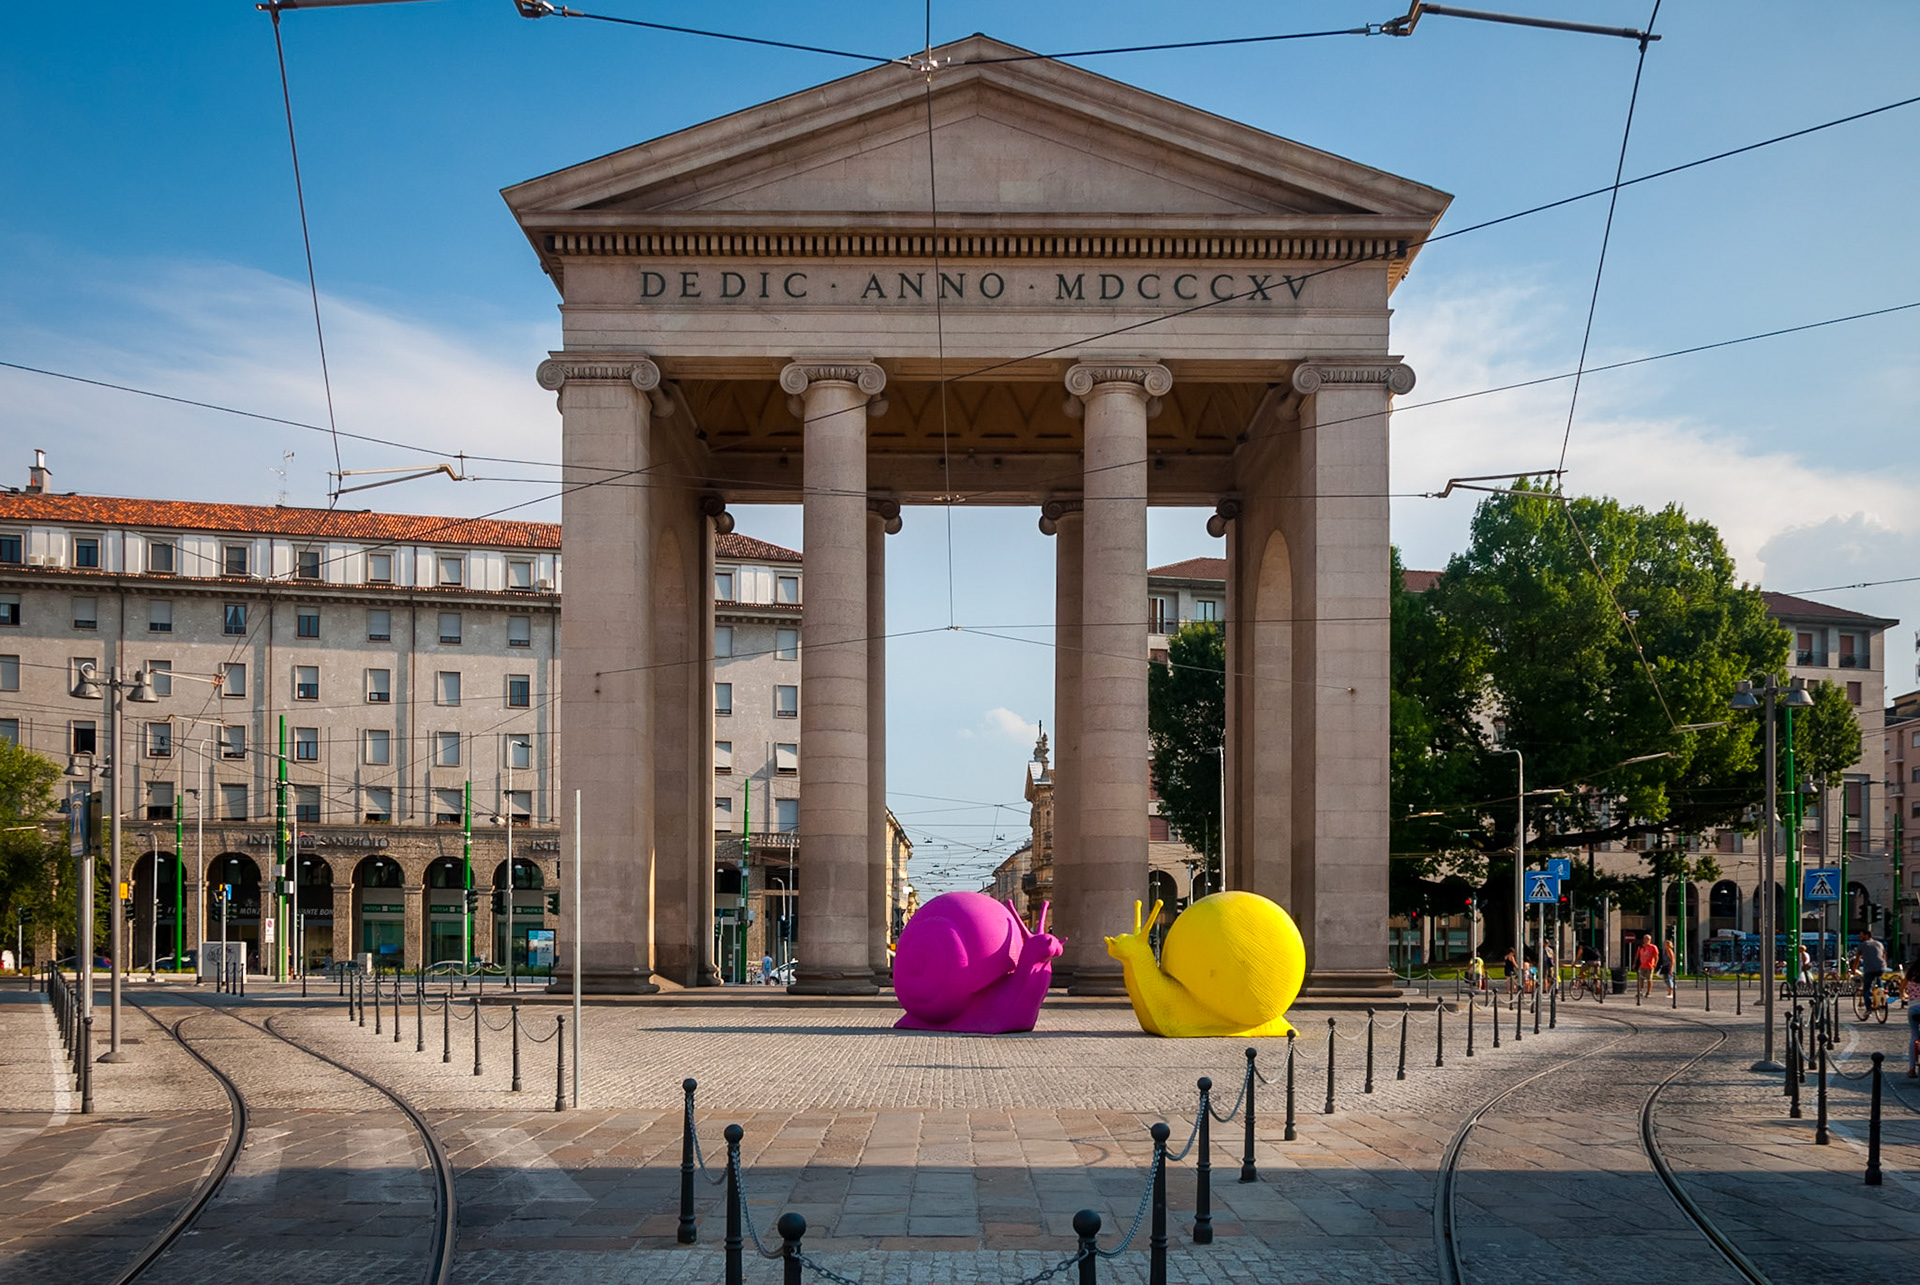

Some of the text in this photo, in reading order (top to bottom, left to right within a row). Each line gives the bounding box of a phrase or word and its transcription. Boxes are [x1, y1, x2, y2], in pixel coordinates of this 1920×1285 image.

[640, 270, 1309, 301] DEDIC ANNO MDCCCXV
